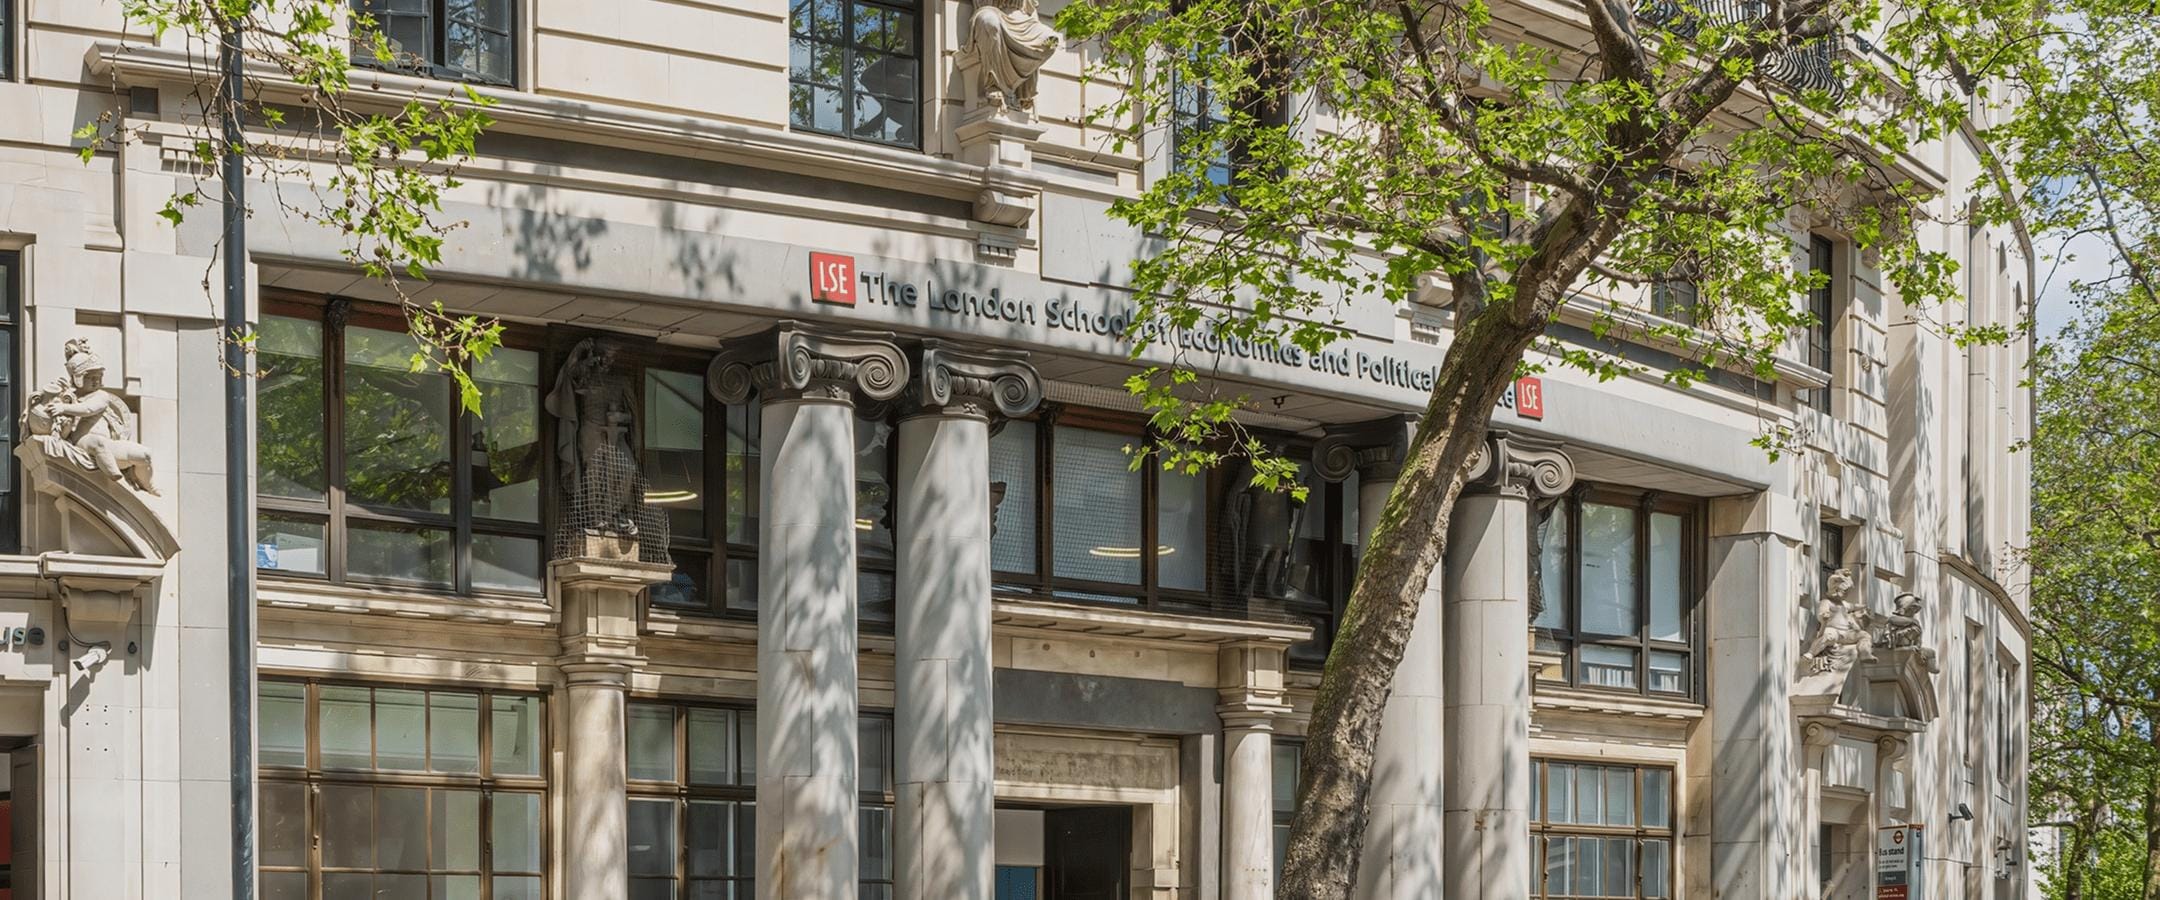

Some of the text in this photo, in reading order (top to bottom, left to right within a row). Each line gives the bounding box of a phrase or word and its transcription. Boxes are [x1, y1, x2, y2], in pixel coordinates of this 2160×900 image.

[819, 260, 849, 294] LSE
[860, 271, 918, 308] The
[927, 280, 1036, 325] London
[1142, 315, 1171, 346] of
[1309, 348, 1350, 377] and
[1356, 351, 1439, 393] Political
[1521, 382, 1539, 410] LSE
